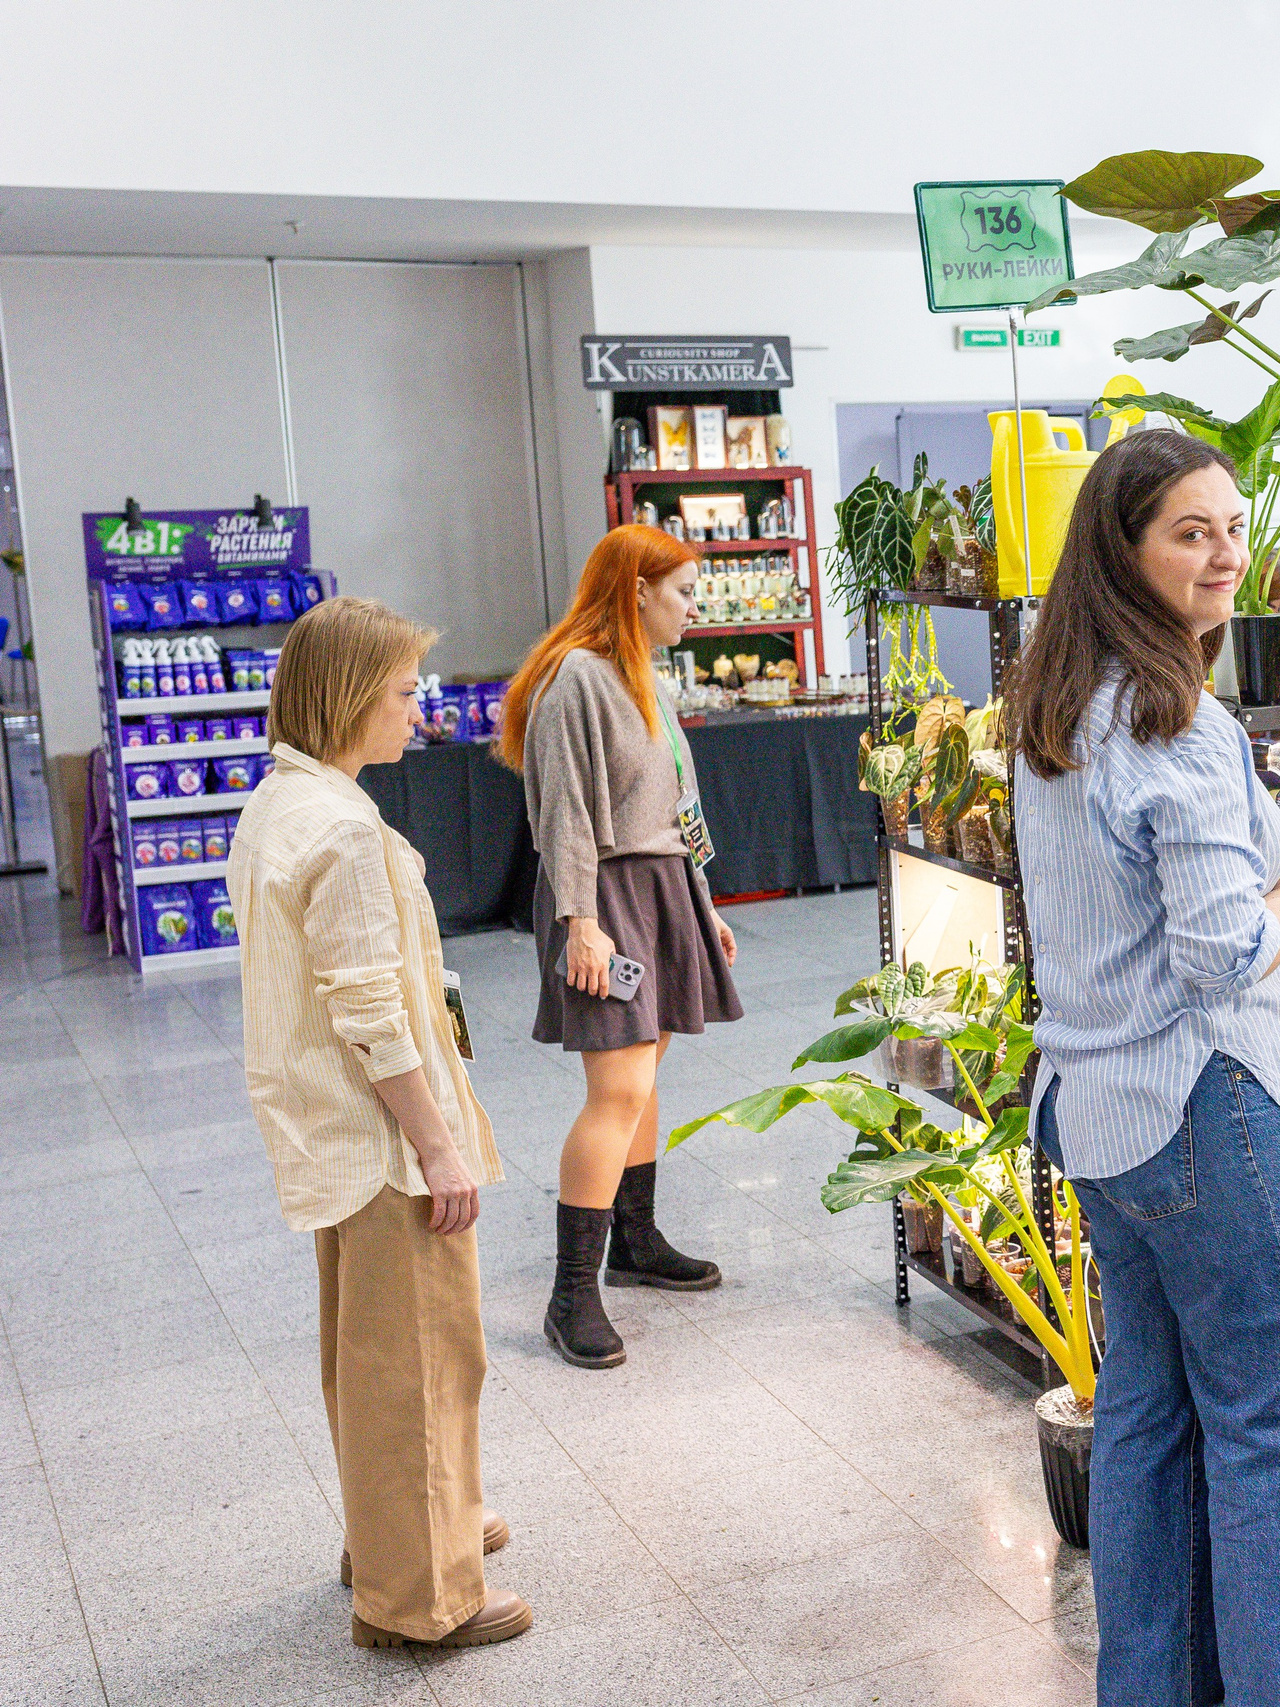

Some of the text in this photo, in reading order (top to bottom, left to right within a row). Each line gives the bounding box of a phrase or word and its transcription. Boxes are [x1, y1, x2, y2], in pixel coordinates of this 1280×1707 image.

[974, 206, 1022, 235] 136
[942, 255, 1063, 281] РУКИ-ЛЕЙКИ
[1023, 331, 1054, 346] EXIT
[583, 342, 791, 383] KUNSTKAMERA
[210, 531, 294, 553] РАСТЕНИЯ
